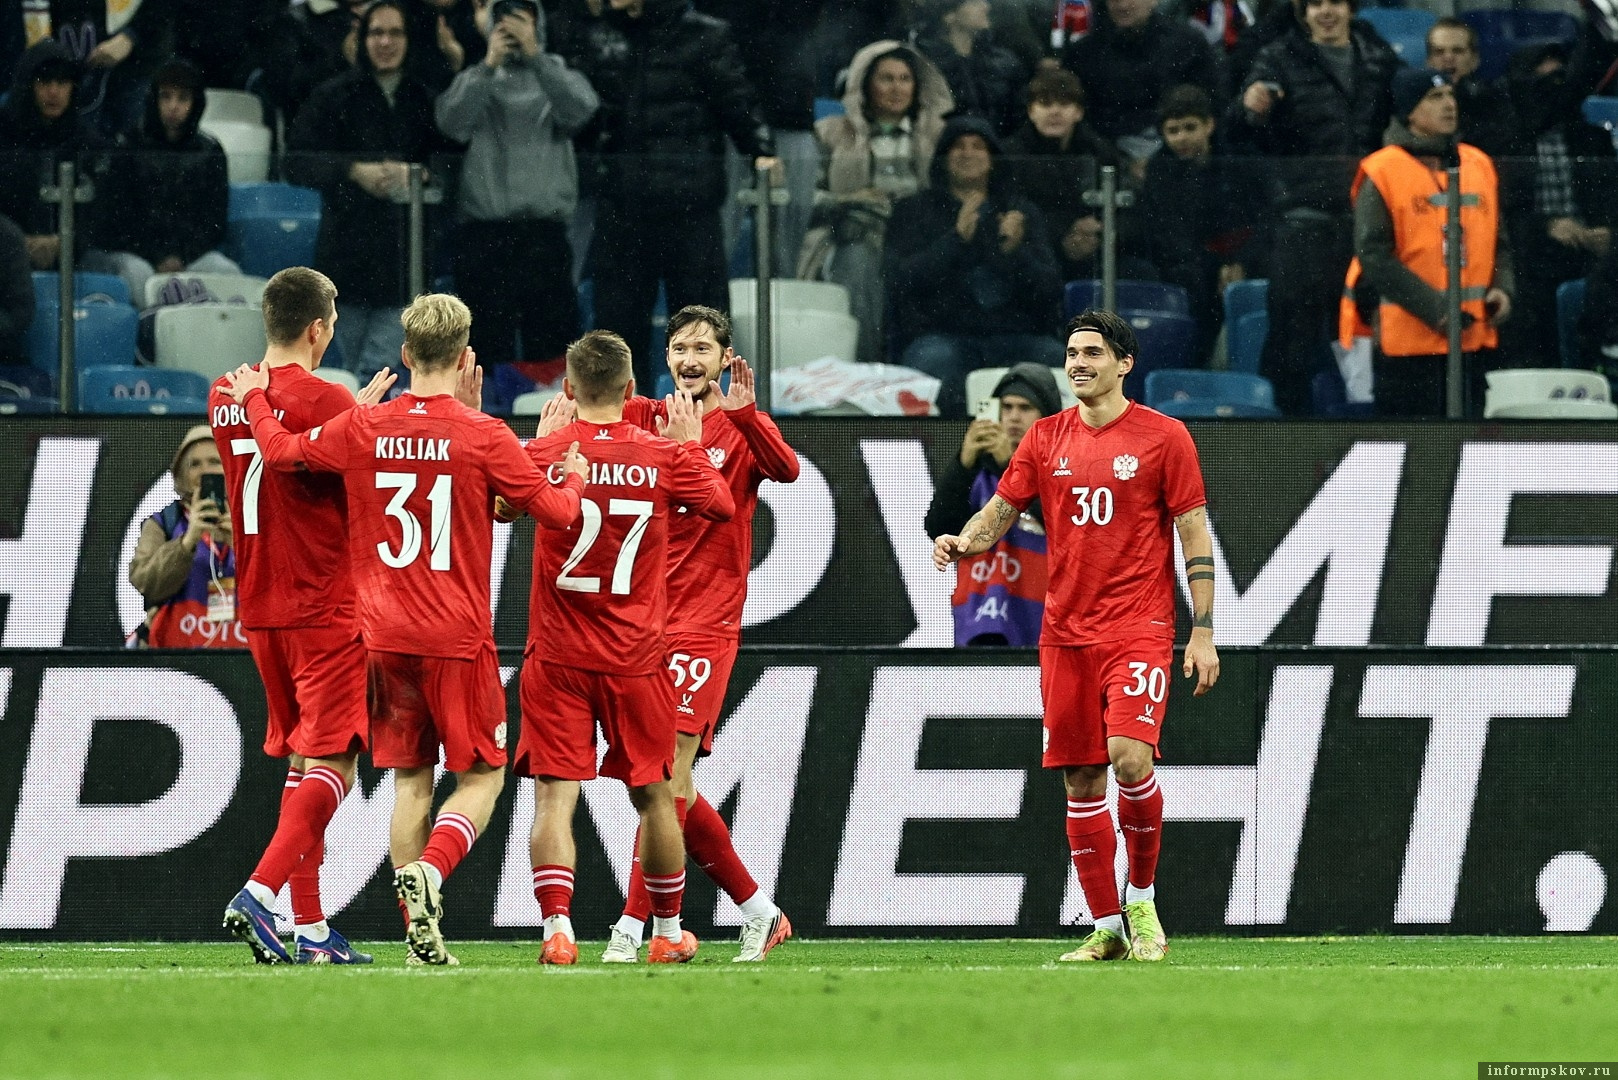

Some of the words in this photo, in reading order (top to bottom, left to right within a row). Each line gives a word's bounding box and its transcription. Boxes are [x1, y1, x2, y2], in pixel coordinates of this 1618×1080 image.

[213, 404, 285, 428] SOBOV
[375, 436, 451, 461] KISLIAK
[230, 438, 264, 535] 7
[1052, 469, 1073, 477] JOGEL
[375, 471, 452, 571] 31
[1070, 486, 1114, 526] 30
[556, 497, 654, 595] 27
[668, 653, 712, 693] 59
[1122, 661, 1166, 703] 30
[1135, 714, 1156, 727] JOGEL
